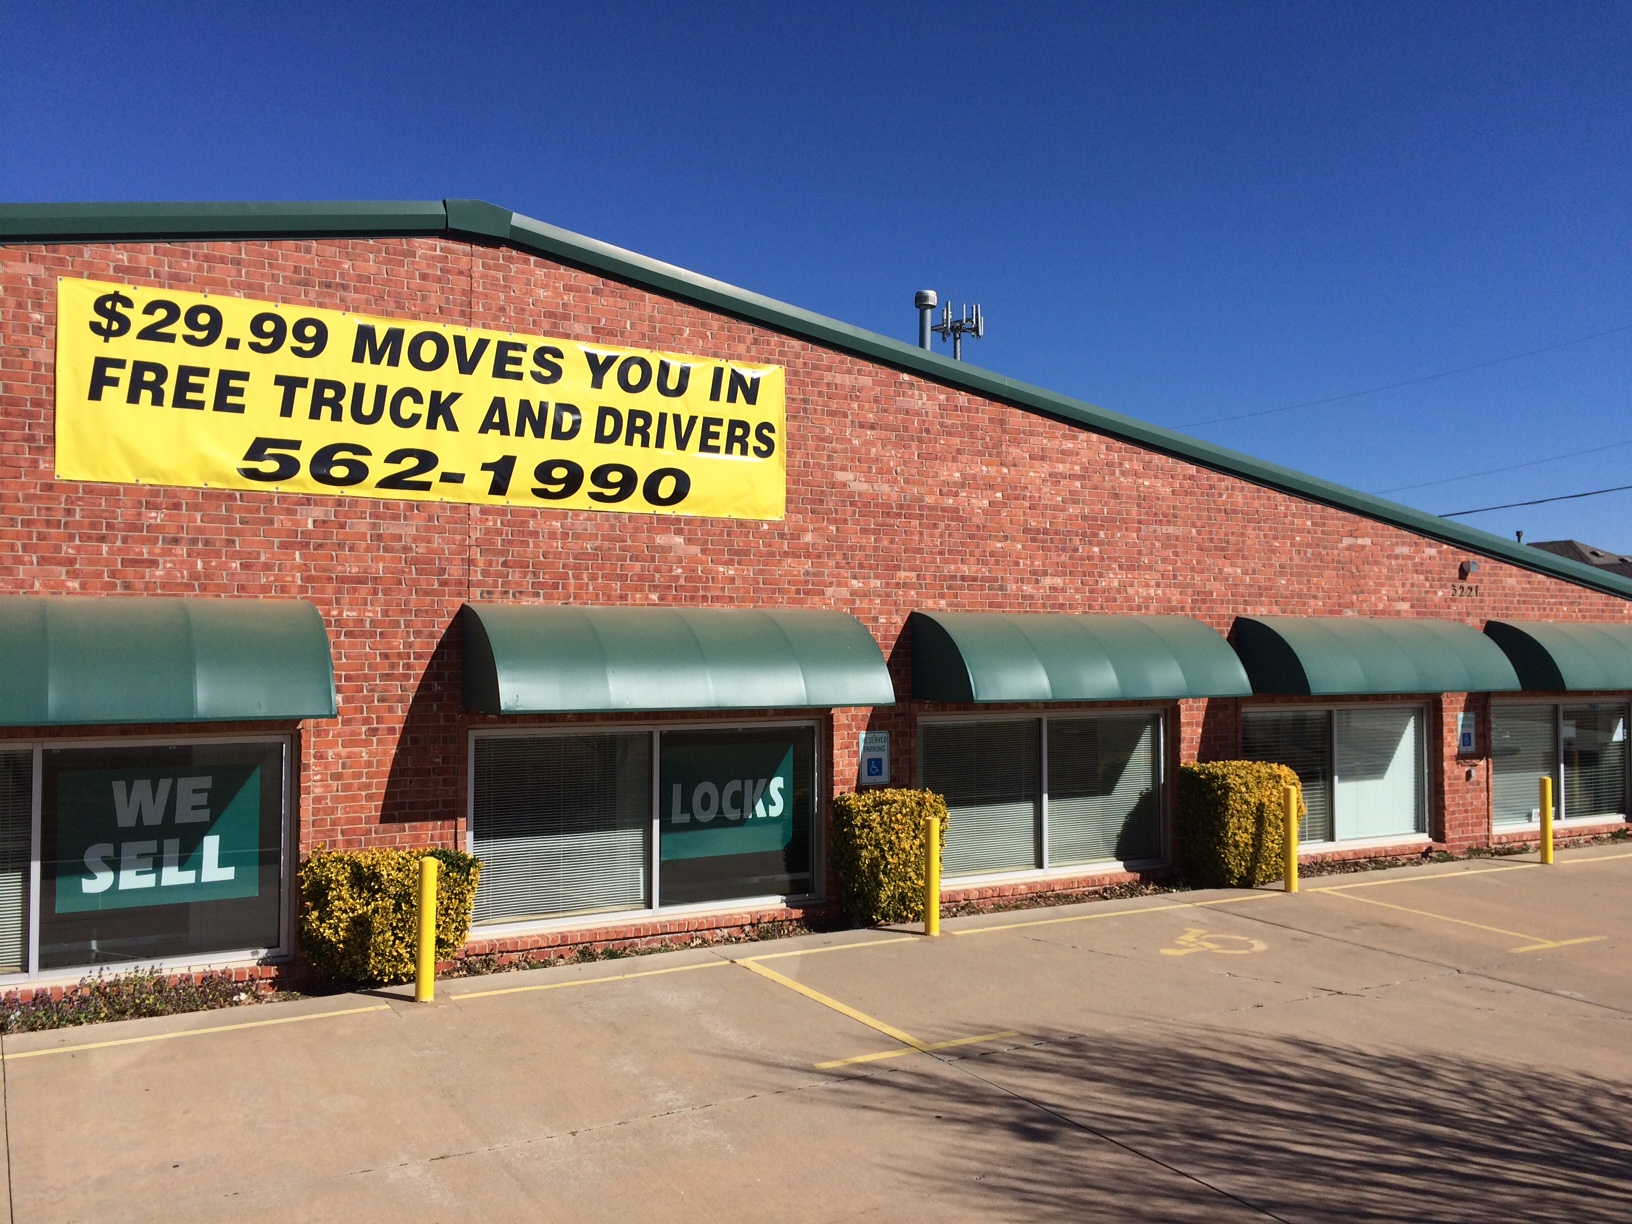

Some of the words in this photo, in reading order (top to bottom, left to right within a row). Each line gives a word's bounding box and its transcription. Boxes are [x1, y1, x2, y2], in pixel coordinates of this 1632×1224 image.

[88, 290, 328, 358] $29.99
[351, 323, 564, 385] MOVES
[584, 350, 691, 397] YOU
[709, 366, 760, 406] IN
[87, 356, 250, 414] FREE
[273, 374, 463, 432] TRUCK
[478, 396, 582, 441] AND
[593, 405, 776, 459] DRIVERS
[236, 436, 691, 507] 562-1990
[862, 736, 888, 744] RESERVED
[863, 744, 886, 753] PARKING
[112, 776, 212, 827] WE
[671, 776, 785, 824] LOCKS
[81, 834, 235, 893] SELL
